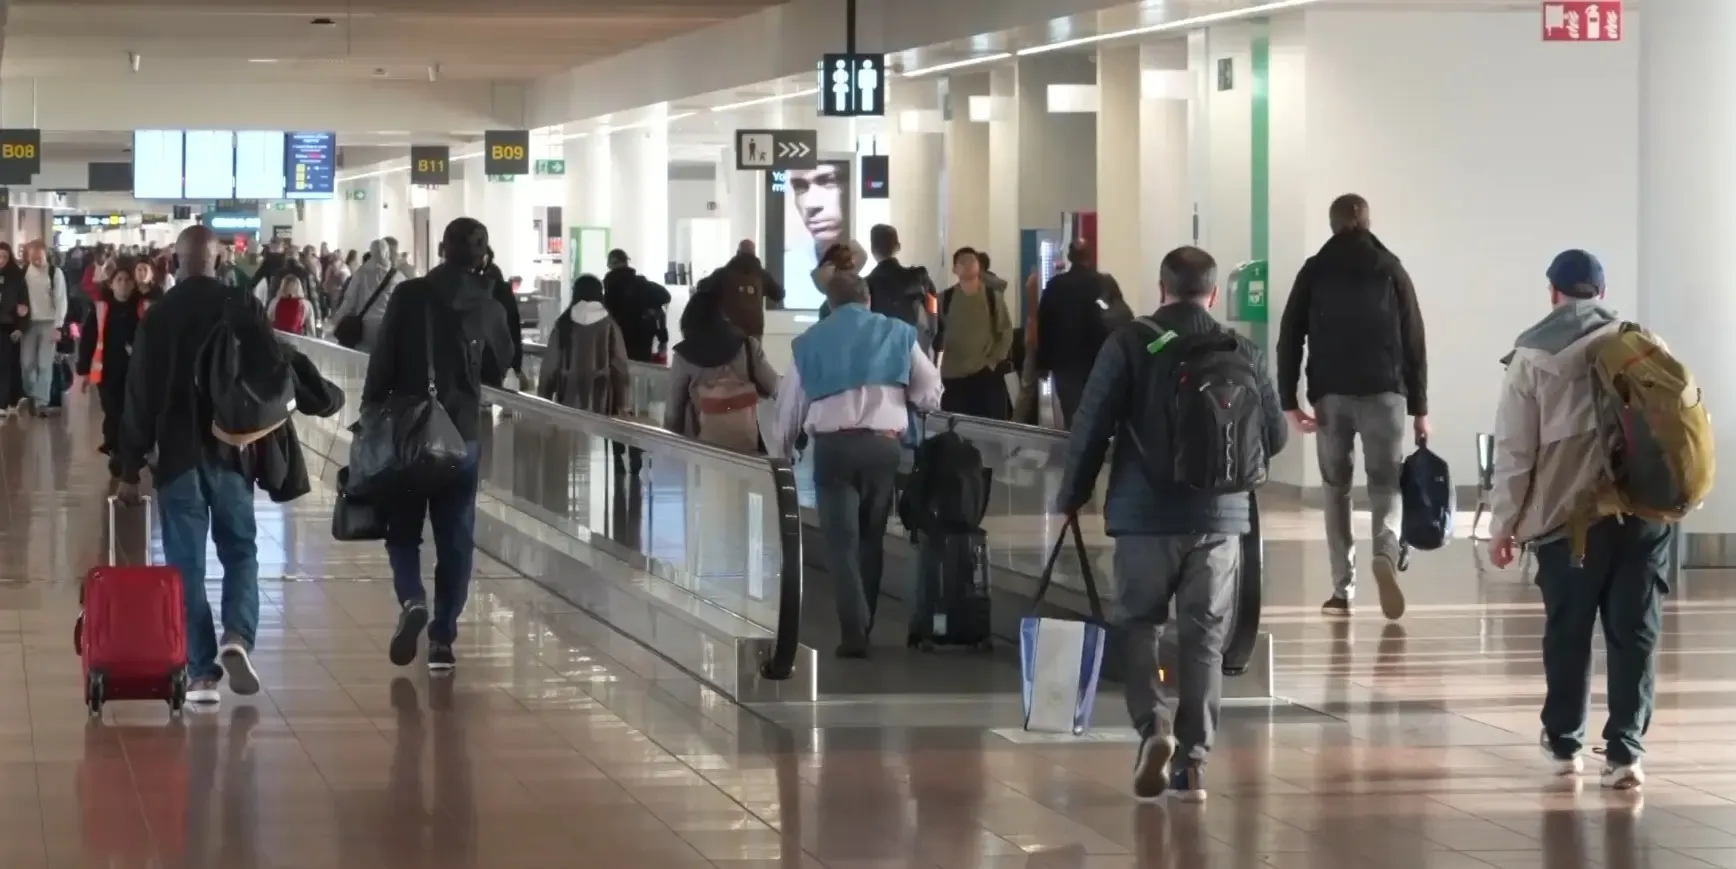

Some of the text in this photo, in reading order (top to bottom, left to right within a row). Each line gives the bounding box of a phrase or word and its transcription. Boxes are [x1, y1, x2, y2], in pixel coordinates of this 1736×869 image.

[2, 143, 35, 159] B08
[491, 145, 524, 160] B09
[418, 160, 444, 172] B11
